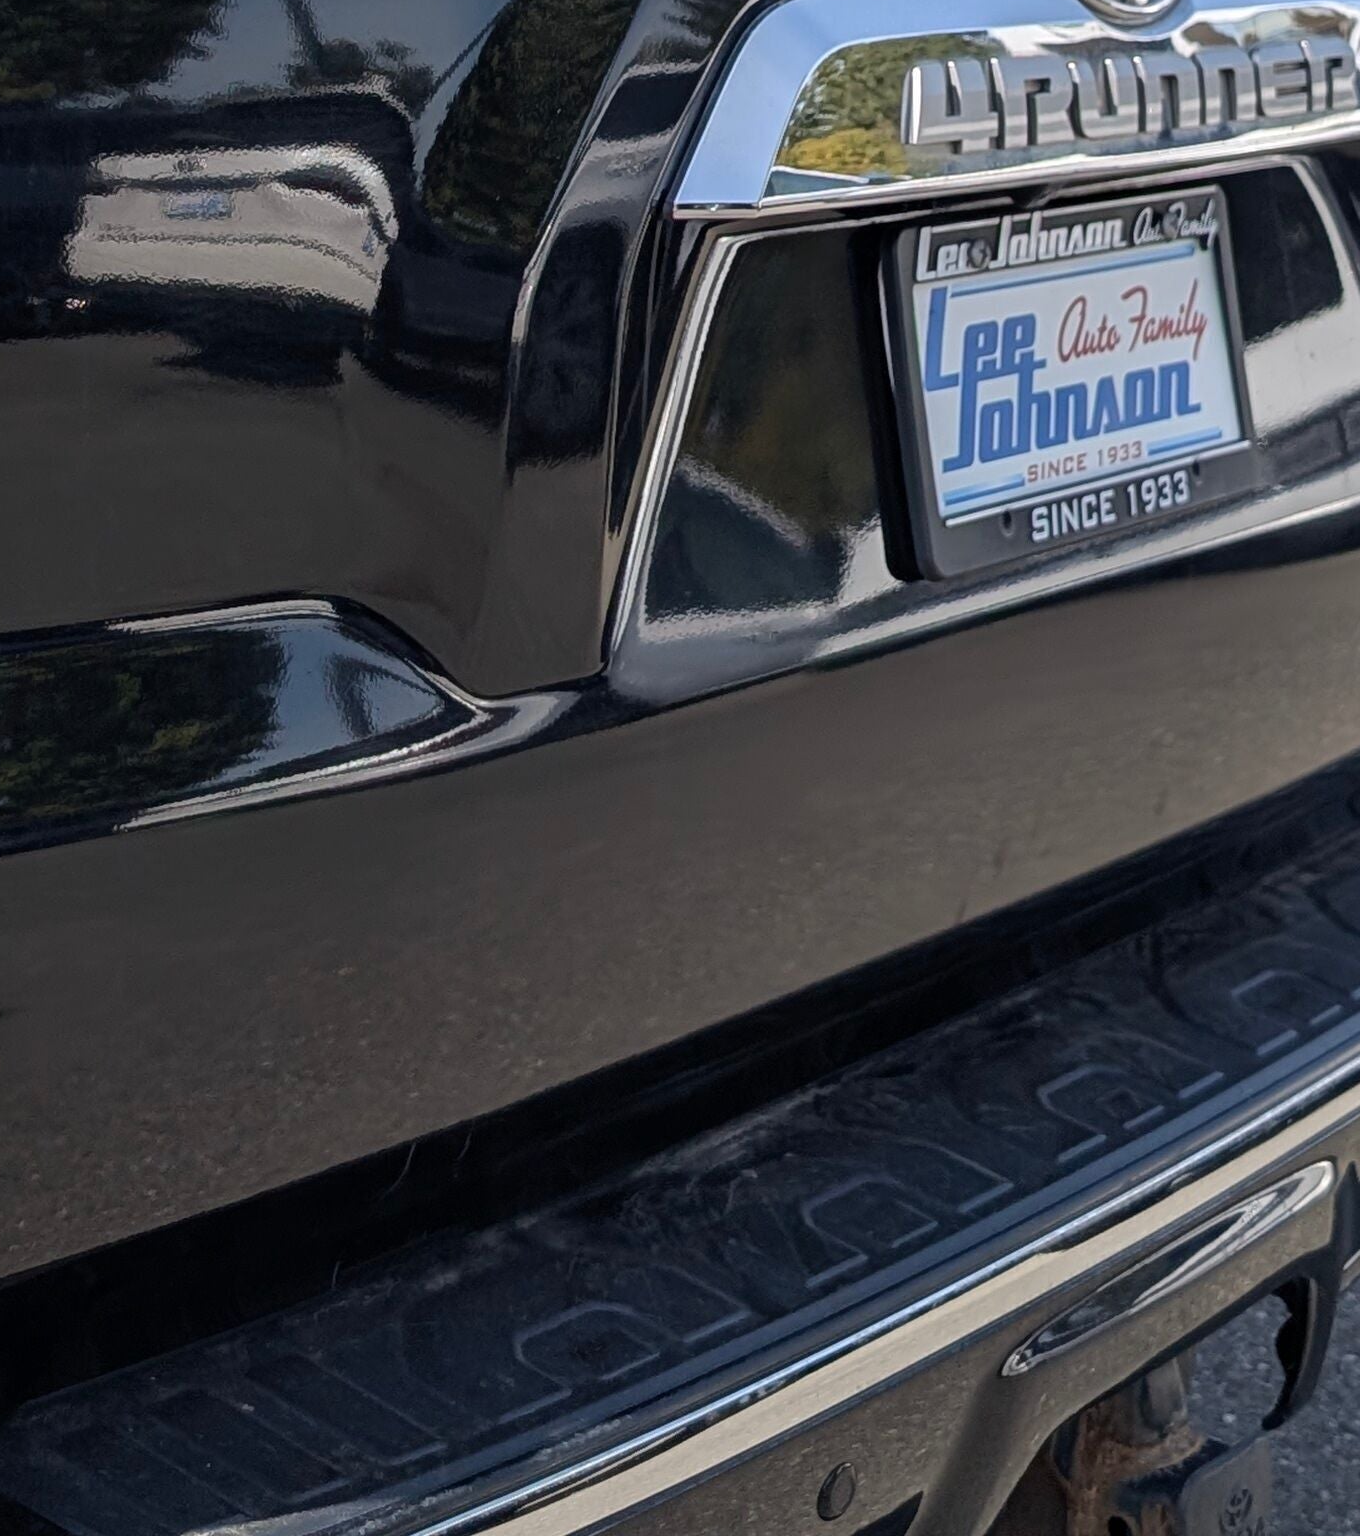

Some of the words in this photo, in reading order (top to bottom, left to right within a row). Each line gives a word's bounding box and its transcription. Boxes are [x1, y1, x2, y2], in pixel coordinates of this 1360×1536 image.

[988, 211, 1128, 270] Johnson
[1133, 206, 1165, 245] Aut
[925, 286, 1046, 392] Lee
[1057, 295, 1120, 362] Auto
[1121, 278, 1207, 360] Family
[942, 360, 1202, 473] Johnson
[1027, 454, 1087, 482] SINCE
[1097, 441, 1142, 467] 1933
[1031, 489, 1117, 542] SINCE
[1126, 470, 1190, 514] 1933
